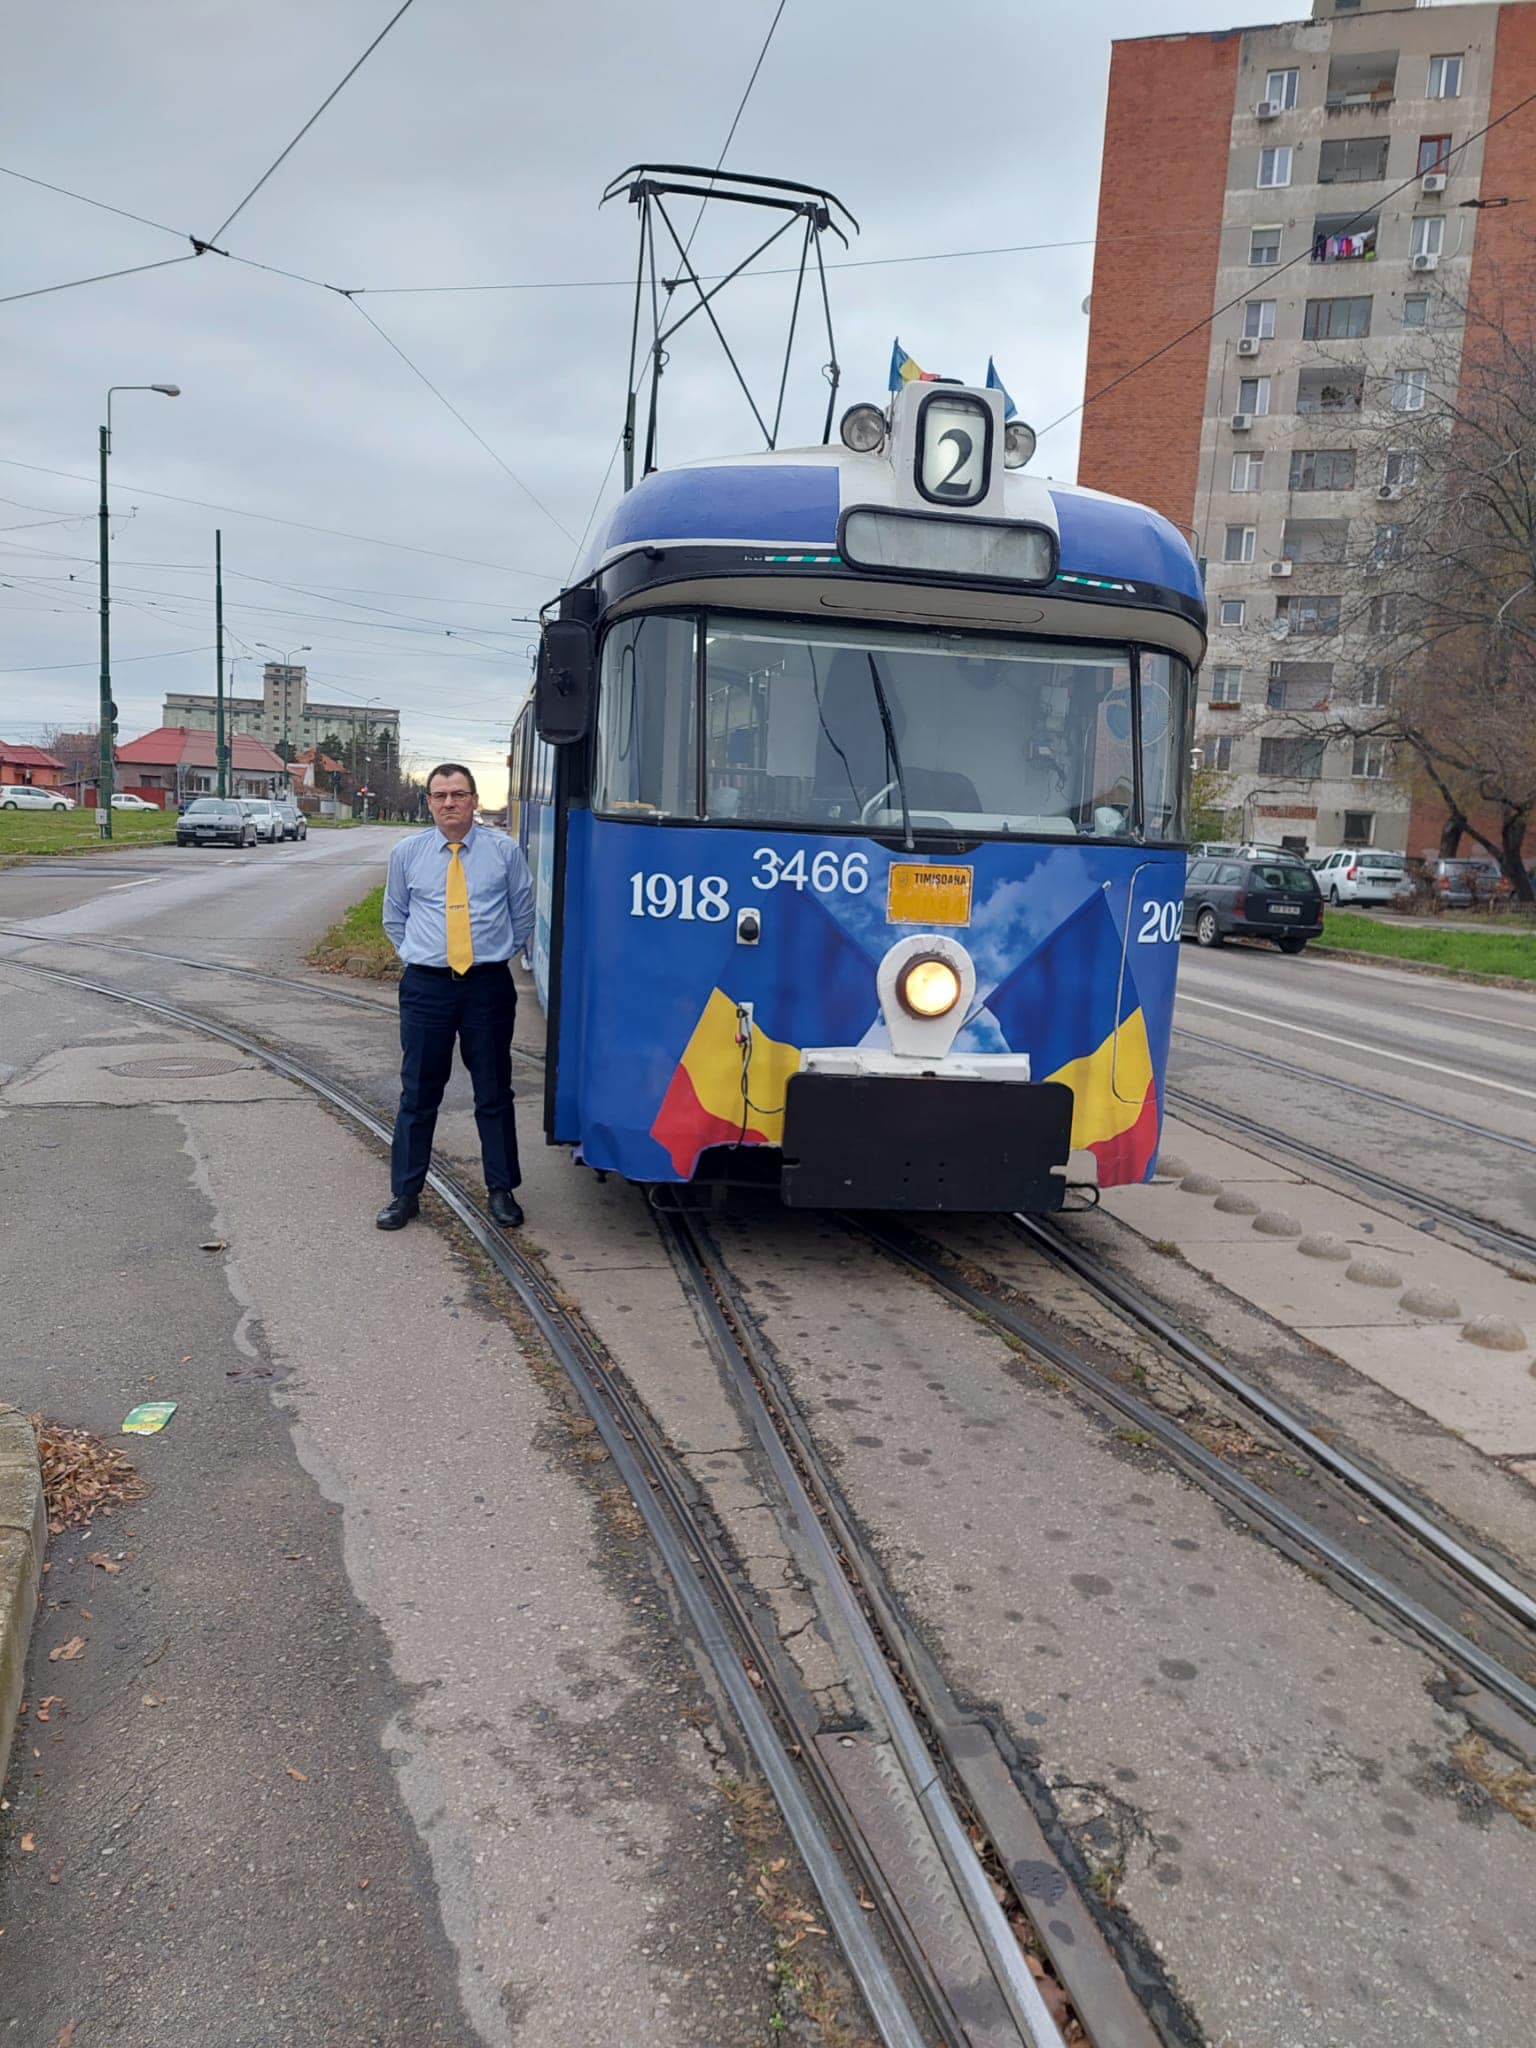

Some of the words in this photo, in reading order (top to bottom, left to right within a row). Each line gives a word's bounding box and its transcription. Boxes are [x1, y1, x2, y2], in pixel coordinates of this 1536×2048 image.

[934, 428, 973, 496] 2
[630, 871, 731, 923] 1918
[751, 848, 869, 894] 3466
